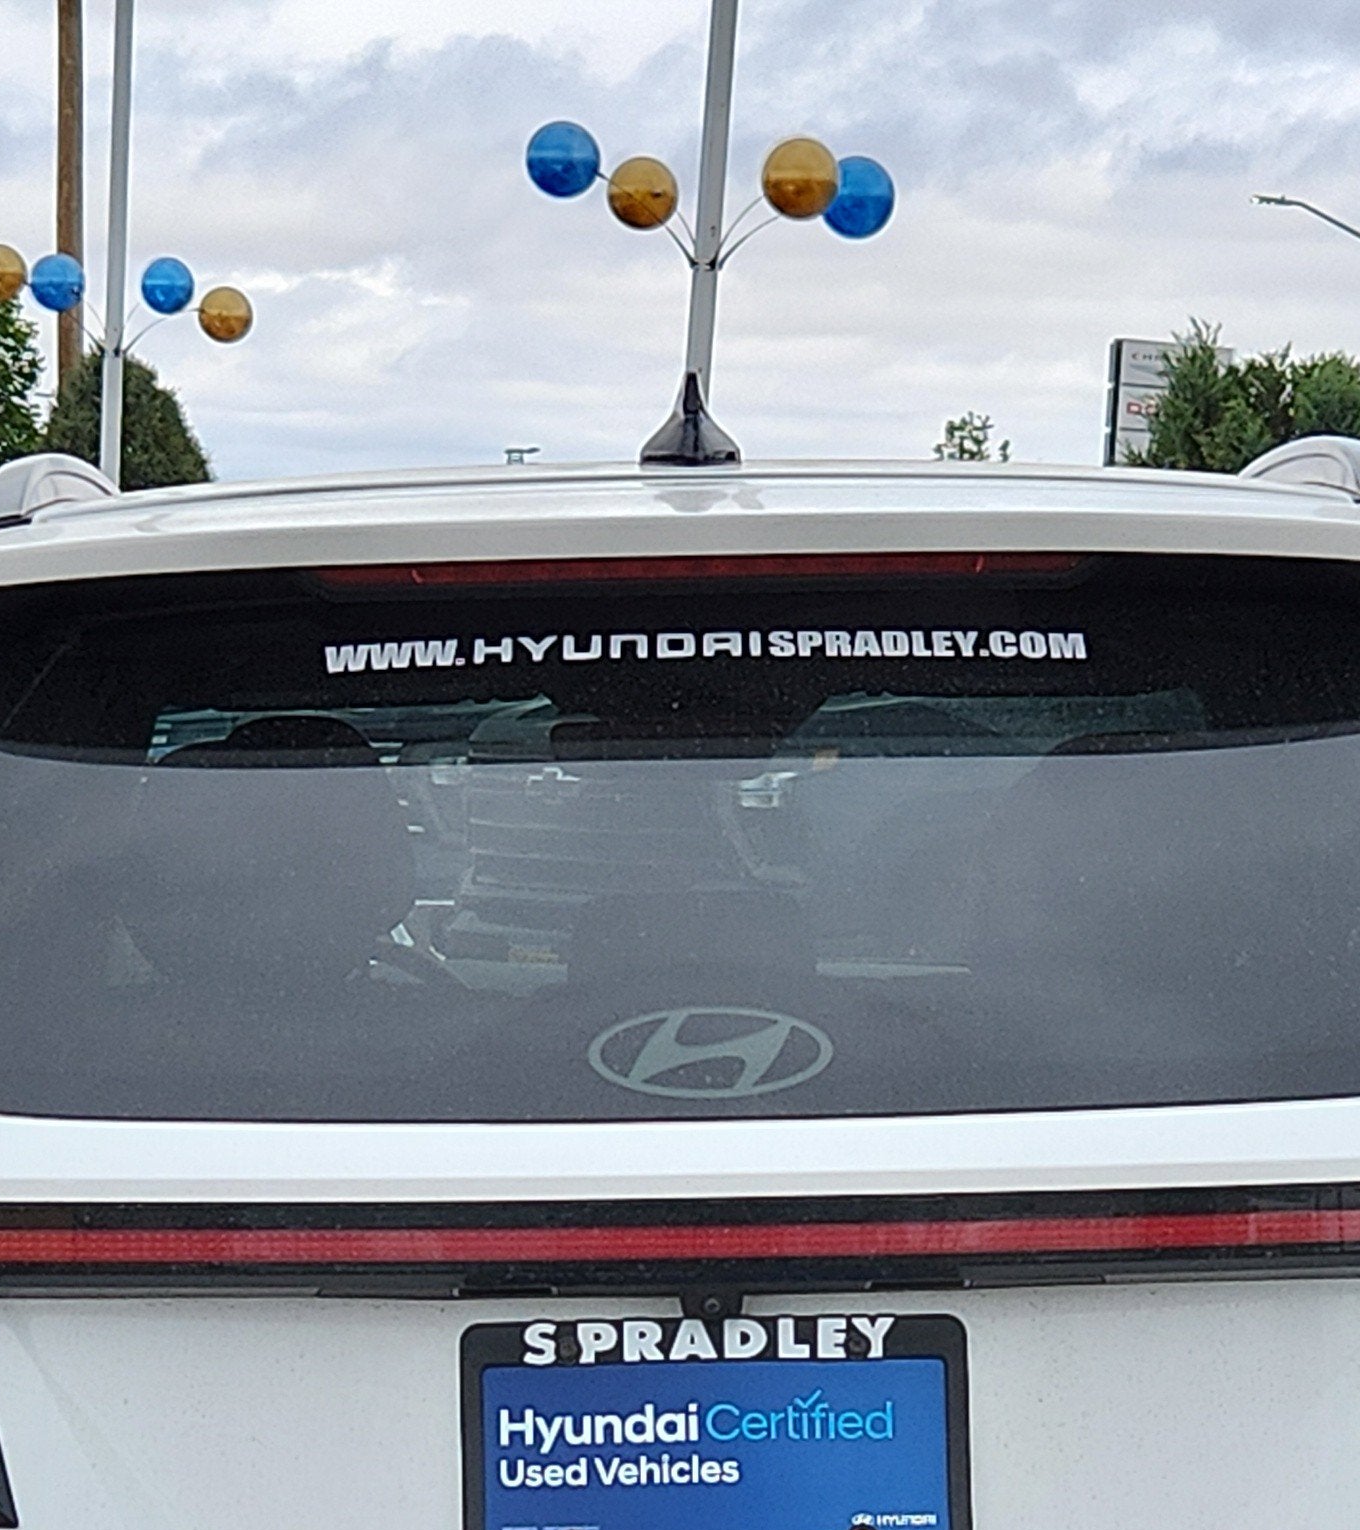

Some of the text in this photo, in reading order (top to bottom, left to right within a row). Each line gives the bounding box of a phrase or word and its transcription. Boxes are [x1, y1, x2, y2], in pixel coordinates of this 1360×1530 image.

[522, 1317, 896, 1365] SPRADLEY
[499, 1389, 895, 1454] Hyundai Certified
[499, 1453, 740, 1488] Used Vehicles
[876, 1514, 938, 1527] HYUNDAI
